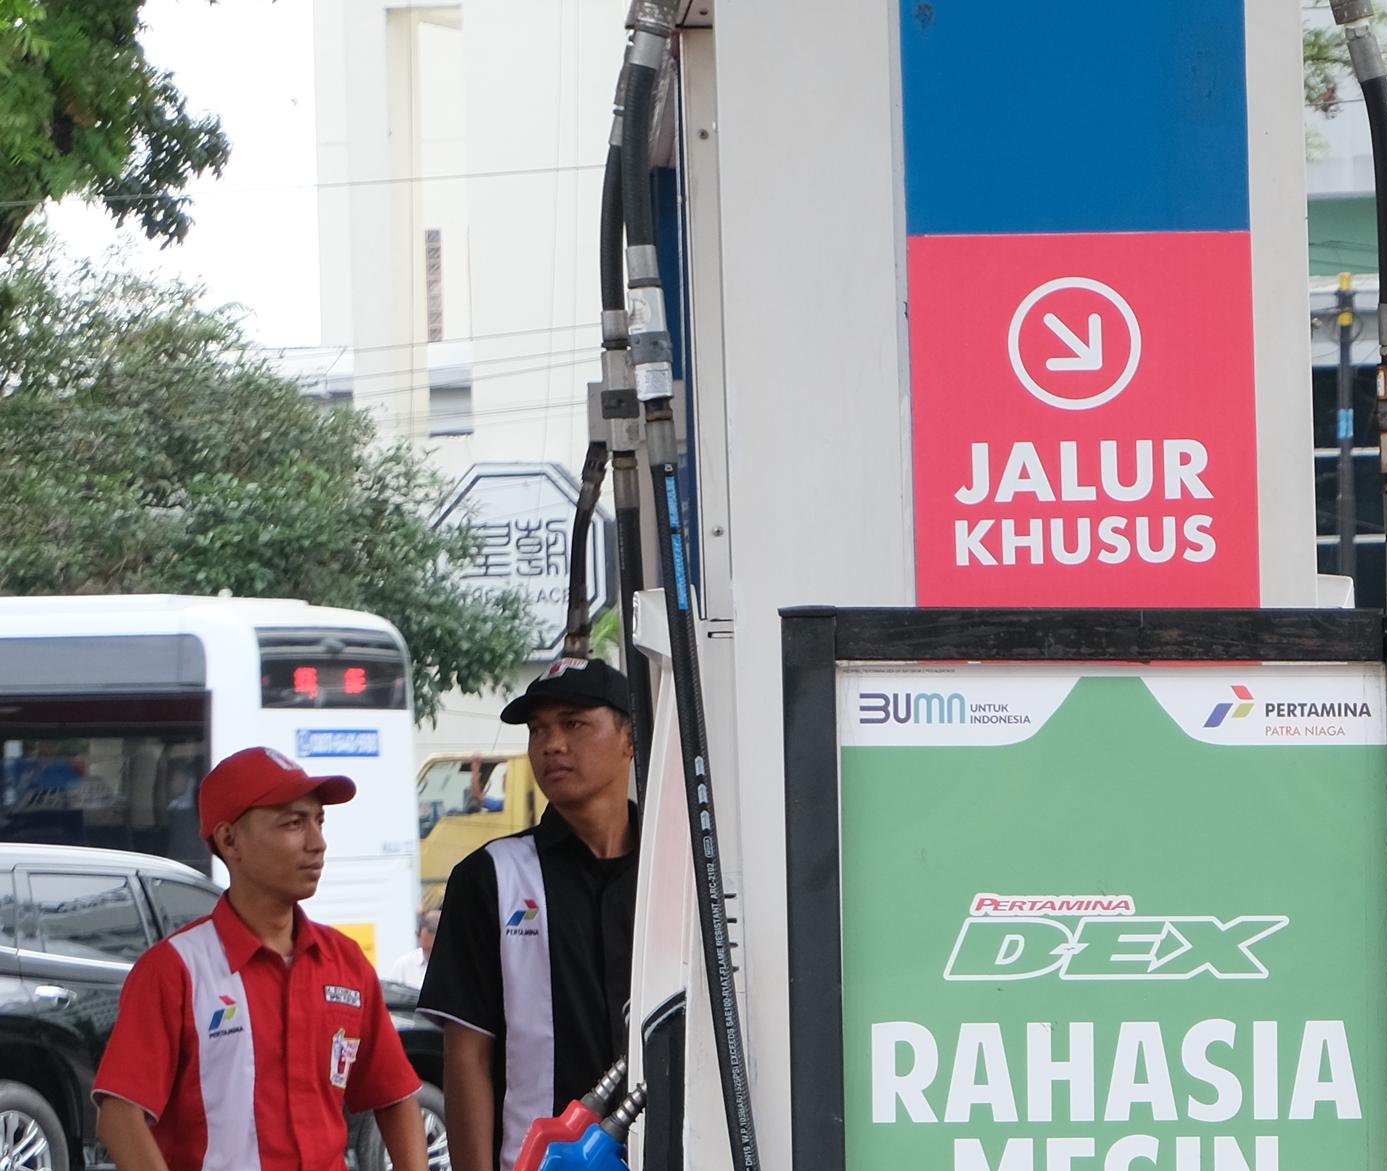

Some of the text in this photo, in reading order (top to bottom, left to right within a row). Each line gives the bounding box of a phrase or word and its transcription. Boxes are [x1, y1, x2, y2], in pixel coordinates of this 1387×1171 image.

[954, 438, 1214, 505] JALUR
[954, 514, 1217, 566] KHUSUS
[859, 693, 966, 724] BUMN
[970, 704, 1009, 714] UNTUK
[970, 715, 1031, 725] INDONESIA
[1265, 702, 1372, 718] PERTAMINA
[1265, 726, 1346, 737] PATRA NIAGA
[973, 896, 1132, 913] PERTAMINA
[710, 903, 724, 946] RESISTANT
[943, 915, 1290, 981] DEX
[727, 1028, 739, 1065] EXCEEDS
[871, 1018, 1363, 1124] RAHASIA
